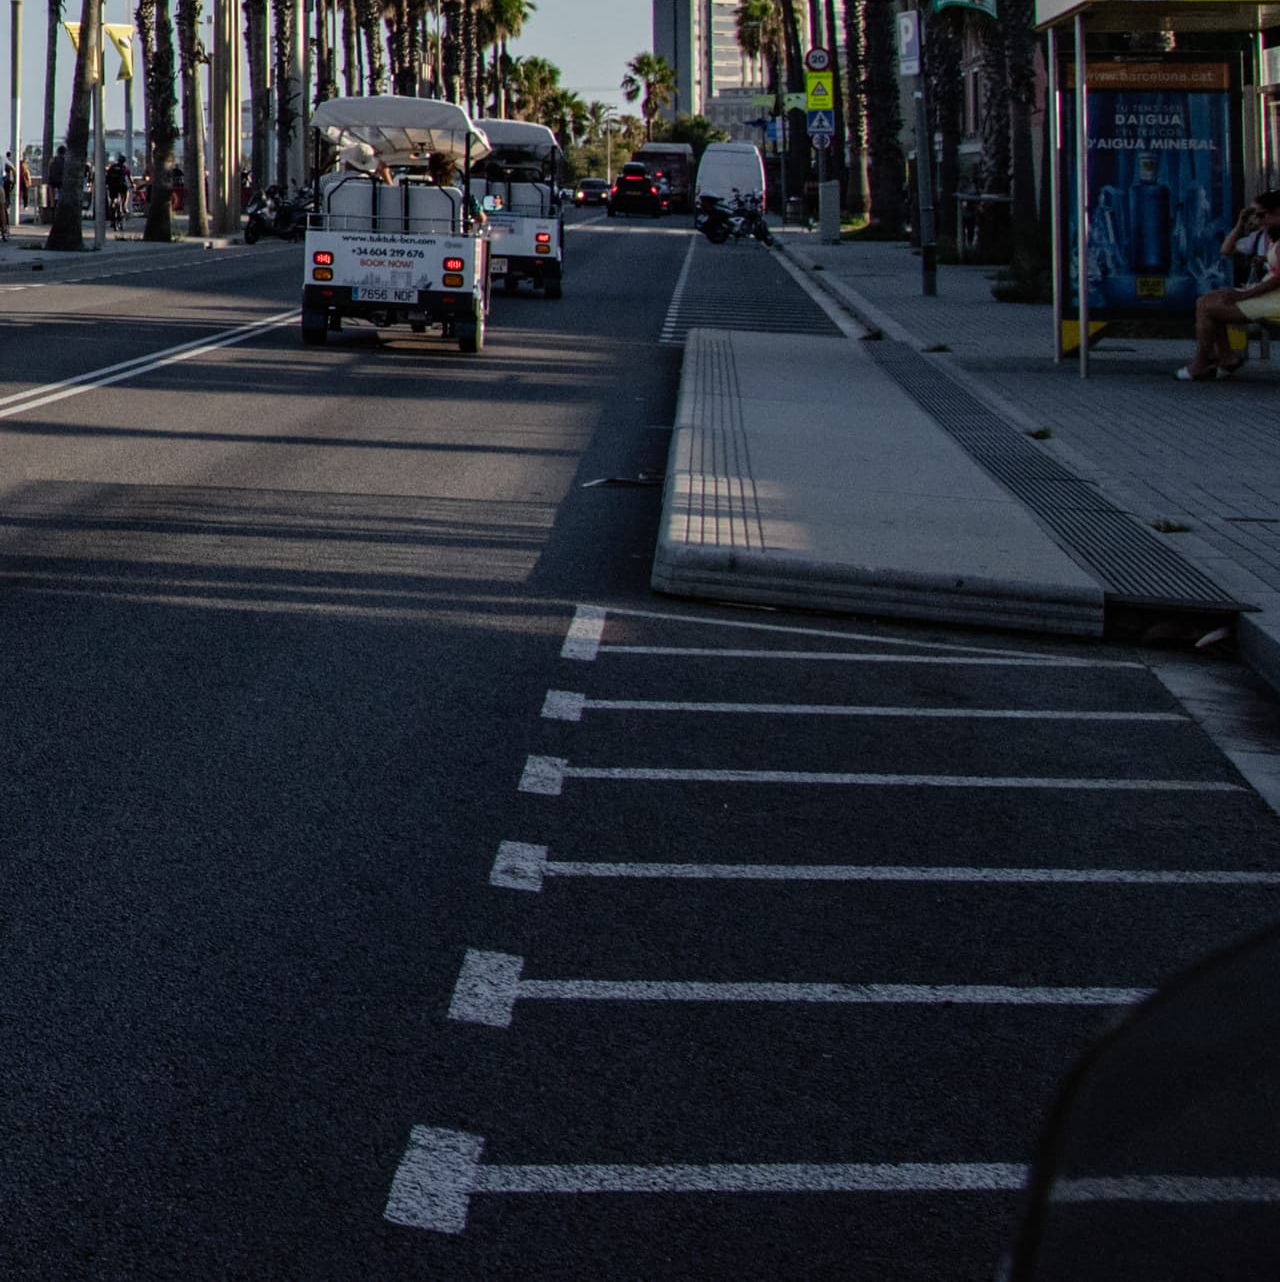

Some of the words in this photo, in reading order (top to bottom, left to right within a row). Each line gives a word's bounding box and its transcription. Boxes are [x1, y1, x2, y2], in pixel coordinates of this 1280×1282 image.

[901, 17, 912, 55] P
[811, 55, 826, 64] 20
[1150, 138, 1217, 150] MINERAL
[342, 233, 437, 246] www.tuktuk-bcn.com
[351, 247, 370, 256] +34
[370, 248, 388, 257] 604
[390, 248, 405, 258] 219
[406, 249, 425, 259] 676
[360, 259, 386, 268] BOOK
[388, 260, 414, 269] NOW!
[394, 290, 414, 302] NDF
